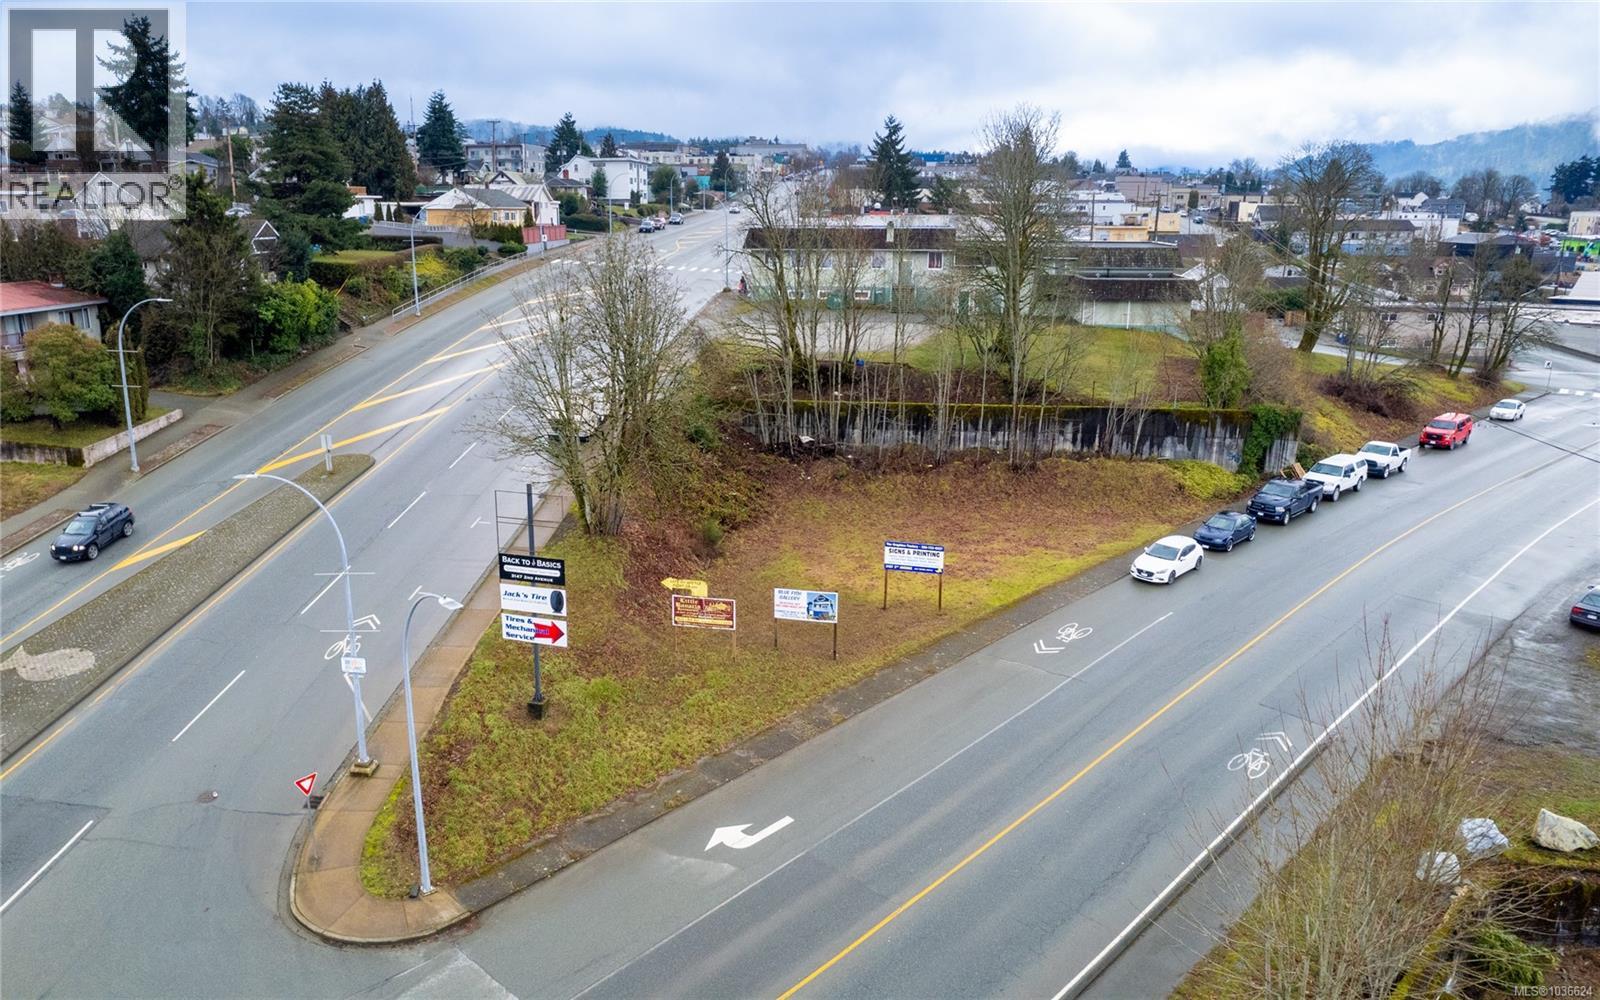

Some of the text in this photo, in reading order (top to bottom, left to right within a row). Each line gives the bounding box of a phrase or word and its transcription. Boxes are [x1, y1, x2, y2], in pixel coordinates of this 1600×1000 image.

[502, 556, 561, 569] BACK TO BASICS
[503, 590, 528, 598] Jack's
[505, 624, 549, 634] Mechanical
[505, 632, 535, 640] Service
